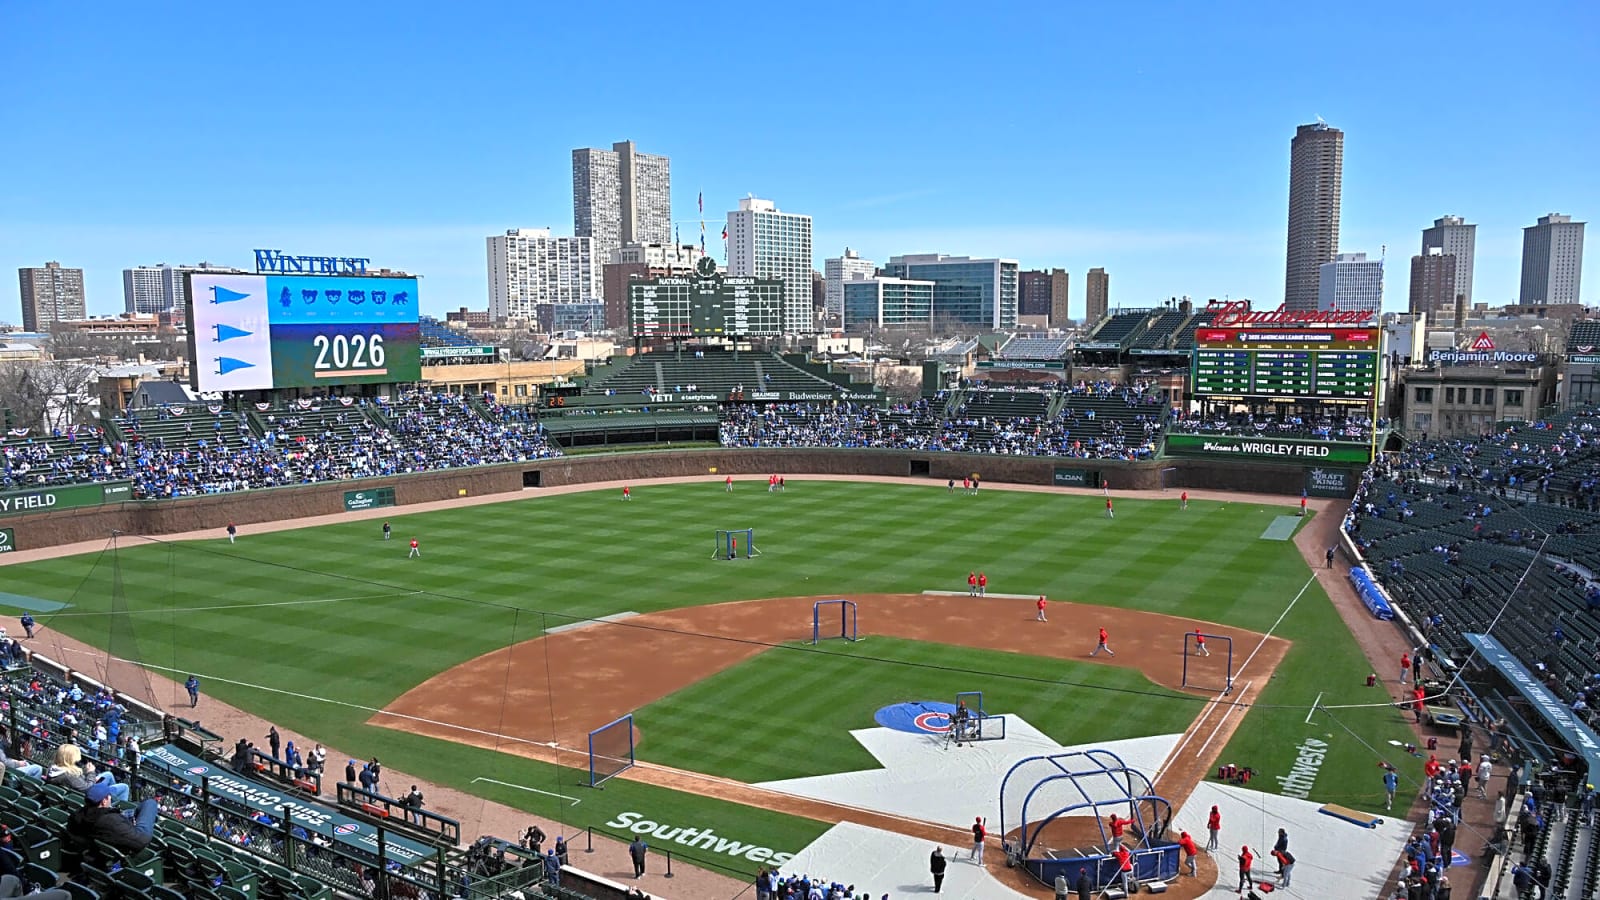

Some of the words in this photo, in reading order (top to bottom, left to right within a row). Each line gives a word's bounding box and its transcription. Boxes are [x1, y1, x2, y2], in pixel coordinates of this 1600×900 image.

[253, 249, 370, 275] WINTRUST
[1207, 301, 1373, 326] Budweiser
[314, 334, 385, 368] 2026
[1432, 350, 1490, 364] Benjamin
[1494, 351, 1536, 362] Moore
[650, 394, 672, 402] YETI
[1203, 442, 1231, 452] Welcome
[1232, 444, 1240, 452] to
[1242, 442, 1293, 455] WRIGLEY
[1296, 445, 1329, 457] FIELD
[1314, 472, 1344, 480] DRAFT
[15, 494, 56, 510] FIELD
[208, 775, 281, 806] CHICAGO
